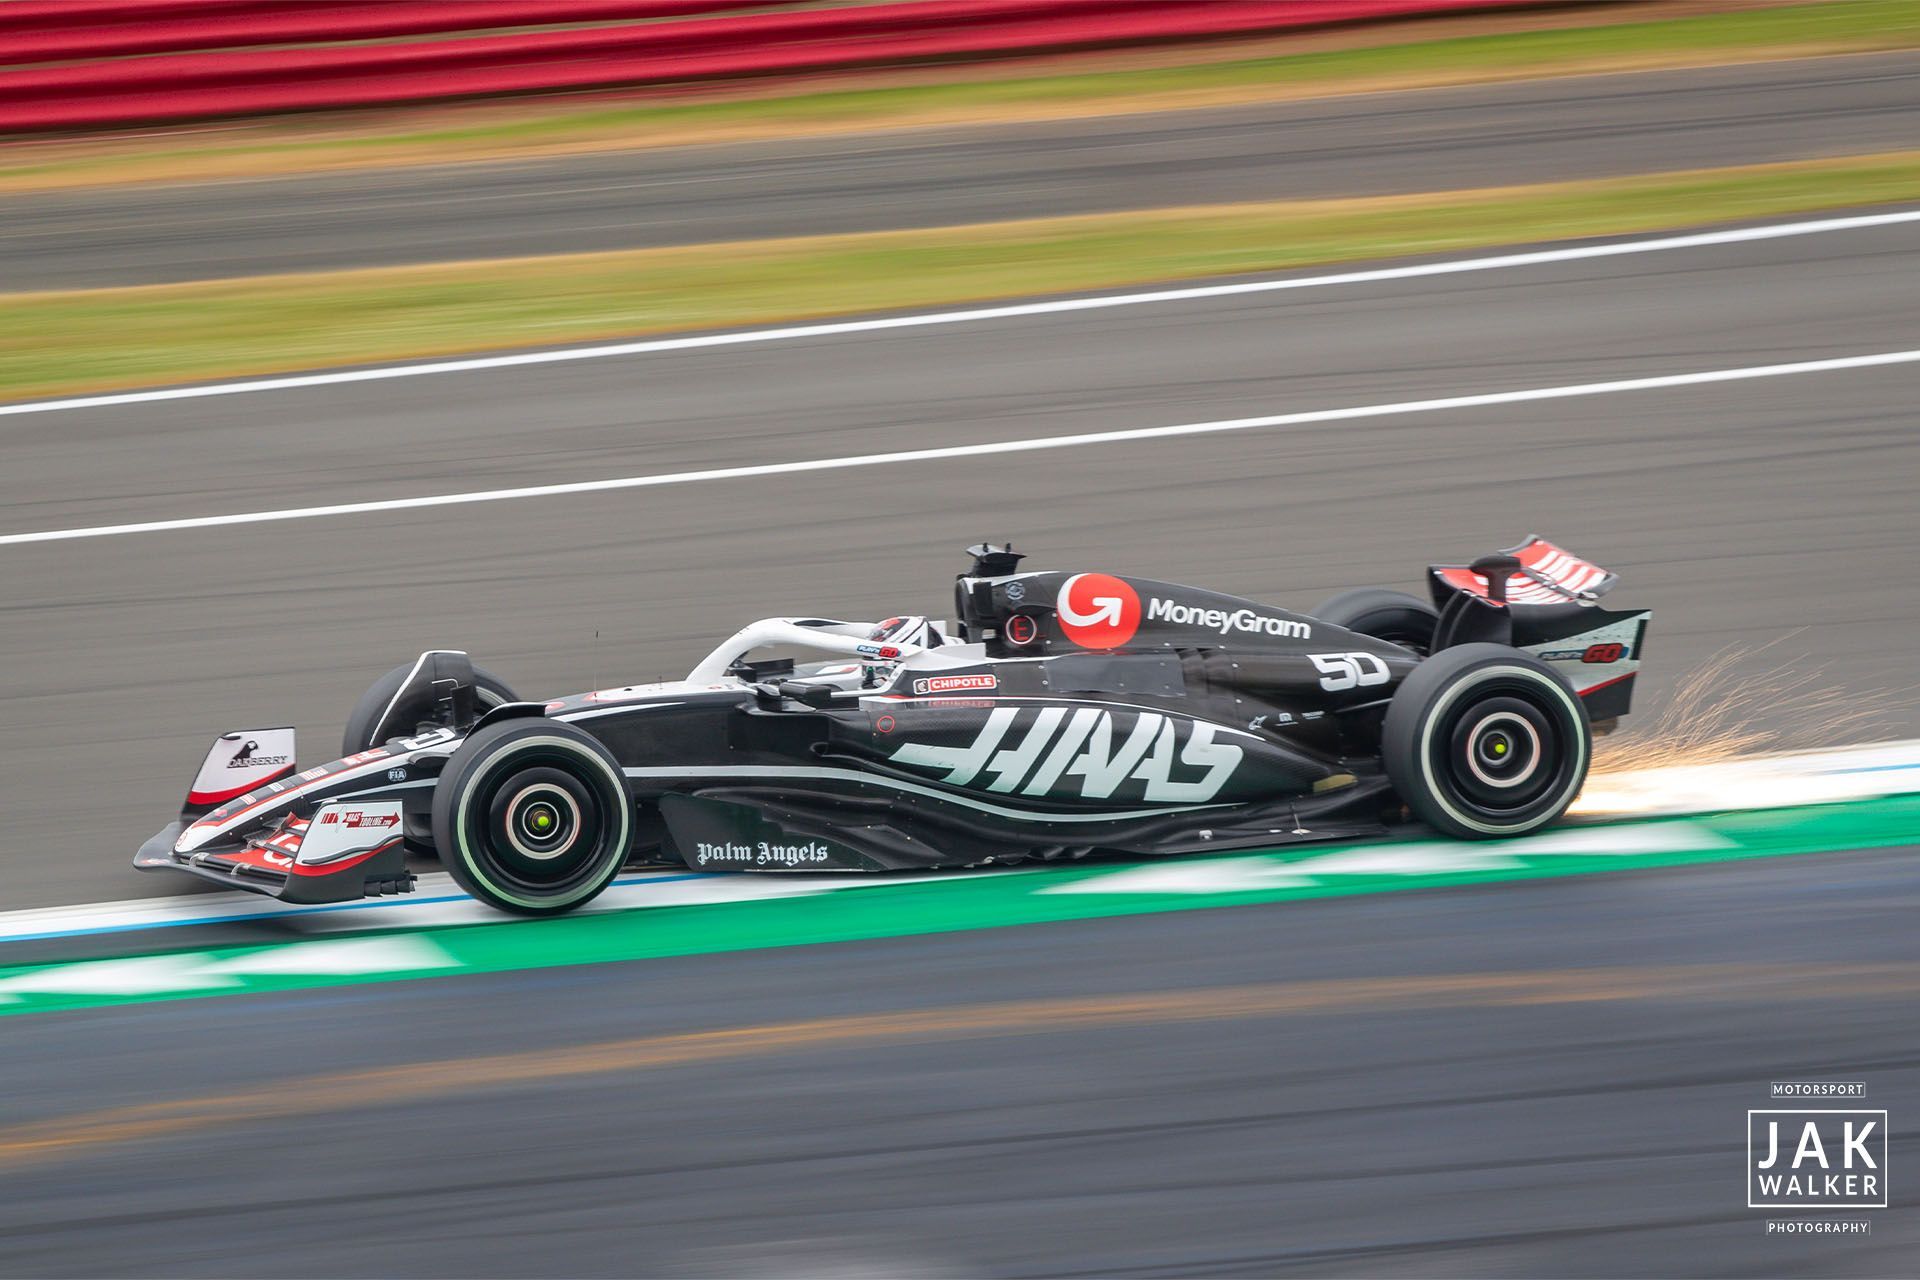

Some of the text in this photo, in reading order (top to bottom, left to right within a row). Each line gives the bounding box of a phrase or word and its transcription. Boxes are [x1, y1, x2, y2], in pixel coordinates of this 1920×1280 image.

[1148, 597, 1311, 639] MoneyGram
[1014, 617, 1029, 641] E
[879, 646, 899, 658] GO
[1582, 643, 1623, 663] GO
[931, 677, 993, 690] CHIPOTLE
[228, 755, 287, 768] OAKBERRY
[888, 707, 1244, 803] HAAS
[389, 770, 406, 779] FIA
[697, 841, 829, 867] Palm Angels
